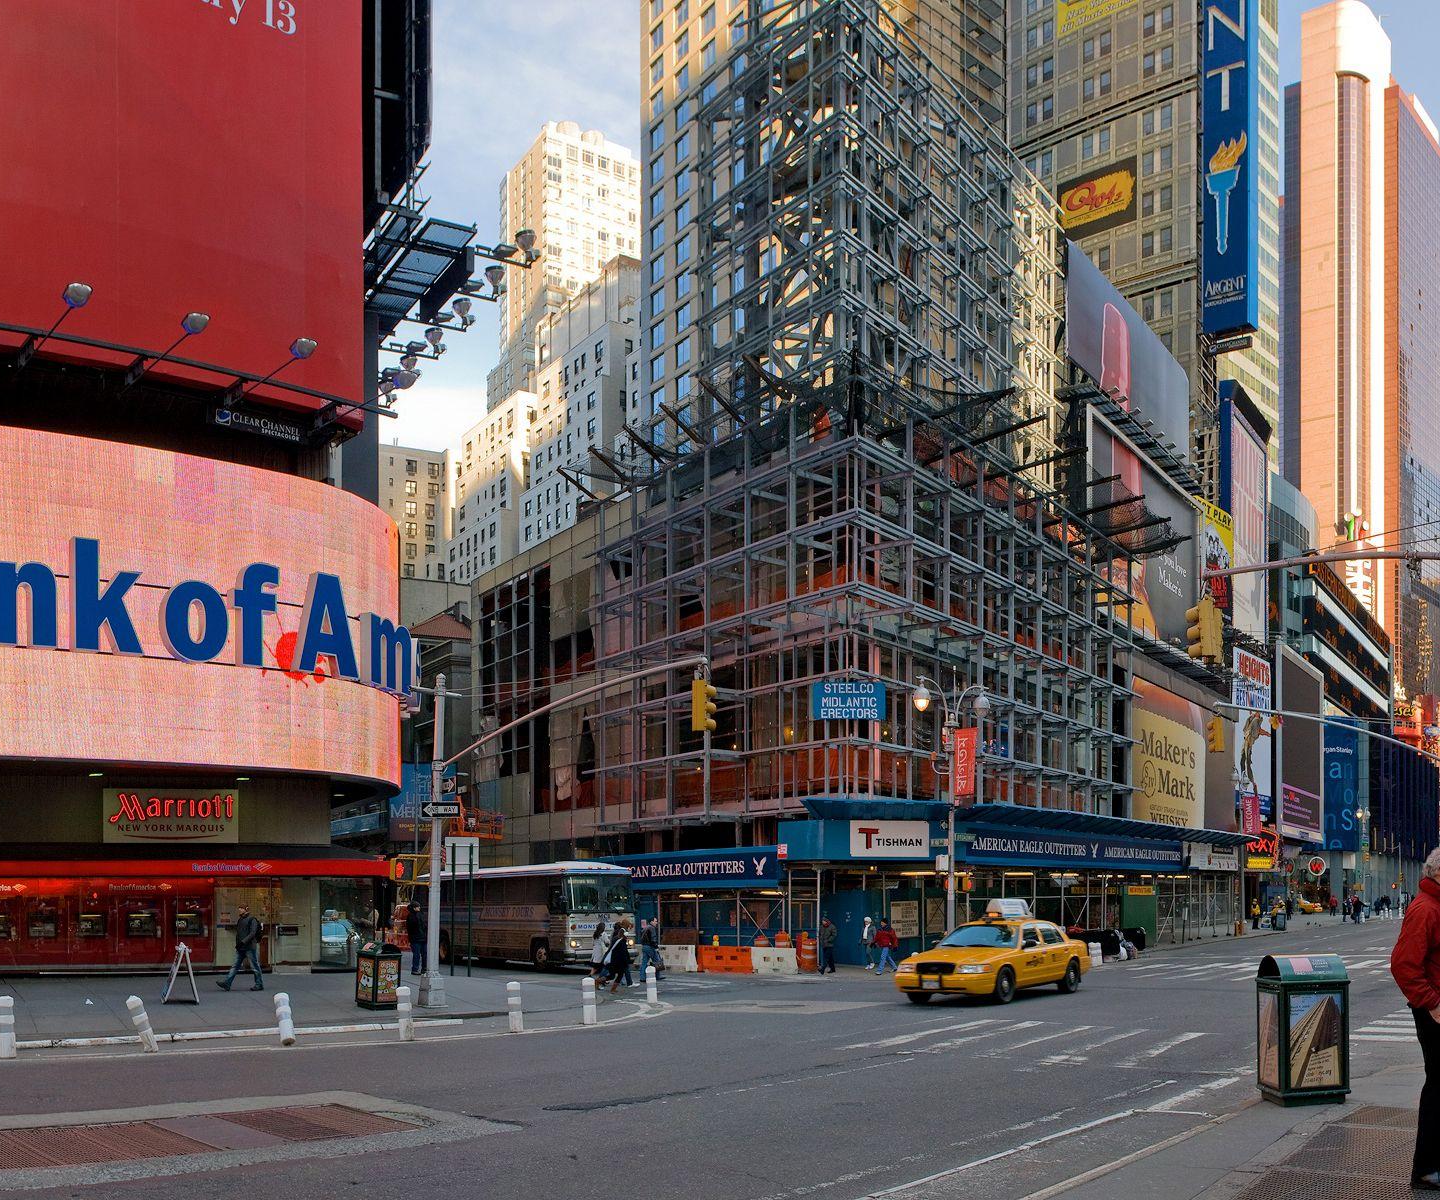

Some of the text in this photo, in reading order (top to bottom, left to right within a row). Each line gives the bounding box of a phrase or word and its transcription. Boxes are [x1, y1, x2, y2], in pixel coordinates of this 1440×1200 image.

[1206, 275, 1247, 298] ARGENT
[1213, 509, 1232, 527] PLAY
[159, 562, 280, 668] of
[1239, 651, 1270, 687] HEIGHTS
[824, 683, 874, 694] STEELCO
[821, 696, 878, 708] MIDLANTIC
[820, 708, 878, 719] ERECTORS
[1140, 728, 1196, 769] Maker's
[1157, 768, 1196, 802] Mark
[109, 792, 234, 824] Marriott
[1150, 812, 1188, 827] WHISKY
[117, 823, 226, 833] NEW YORK MARQUIS
[876, 837, 923, 848] TISHMAN
[972, 837, 1018, 852] AMERICAN
[1020, 840, 1044, 854] EAGLE
[1044, 841, 1087, 857] OUTFITTERS
[1104, 847, 1181, 862] AMERICAN EAGLE OUTFITTERS
[651, 860, 745, 876] EAGLE OUTFITTERS
[485, 904, 535, 918] MONSEY TOURS
